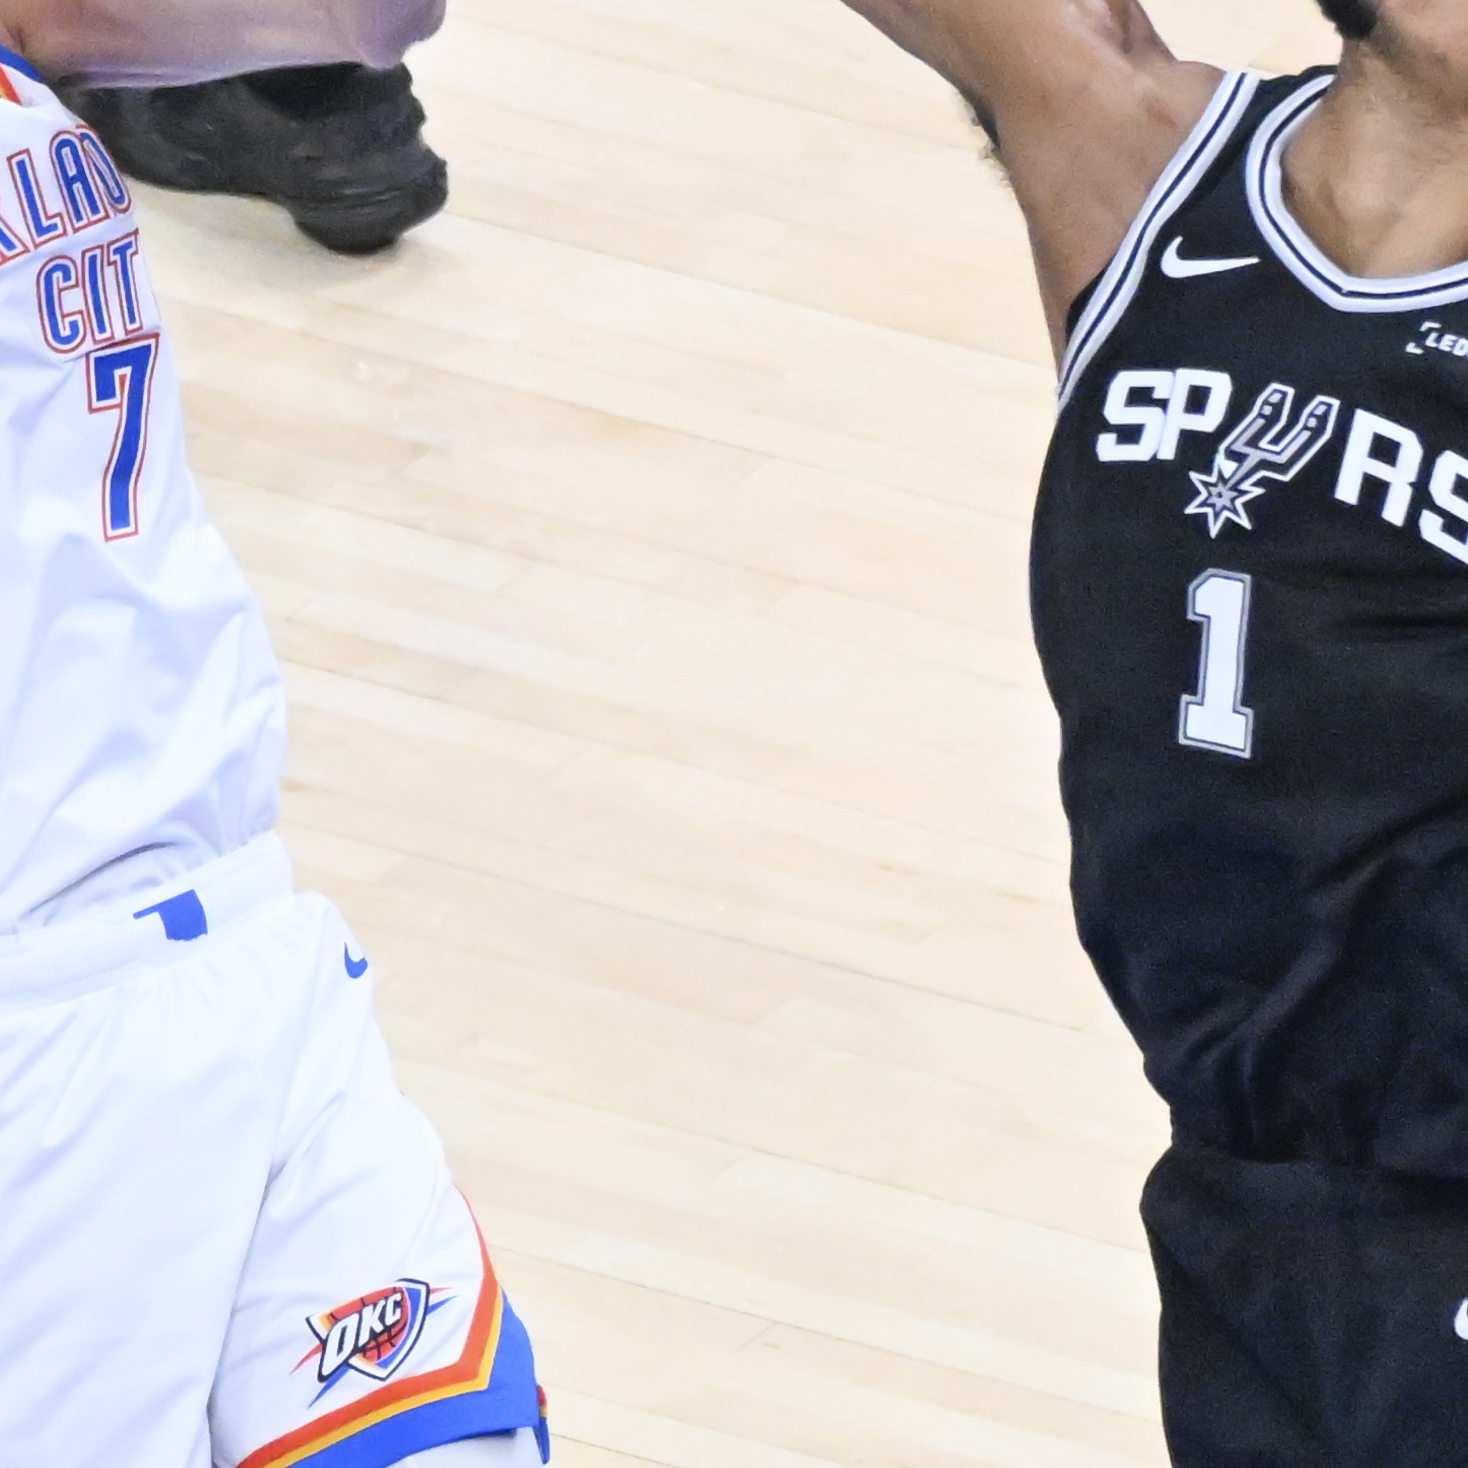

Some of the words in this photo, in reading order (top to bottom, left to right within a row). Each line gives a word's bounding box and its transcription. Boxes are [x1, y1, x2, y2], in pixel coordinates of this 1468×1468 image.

[36, 227, 144, 354] CIT
[86, 332, 160, 542] 7
[1178, 568, 1254, 759] 1
[319, 1292, 403, 1379] OKC
